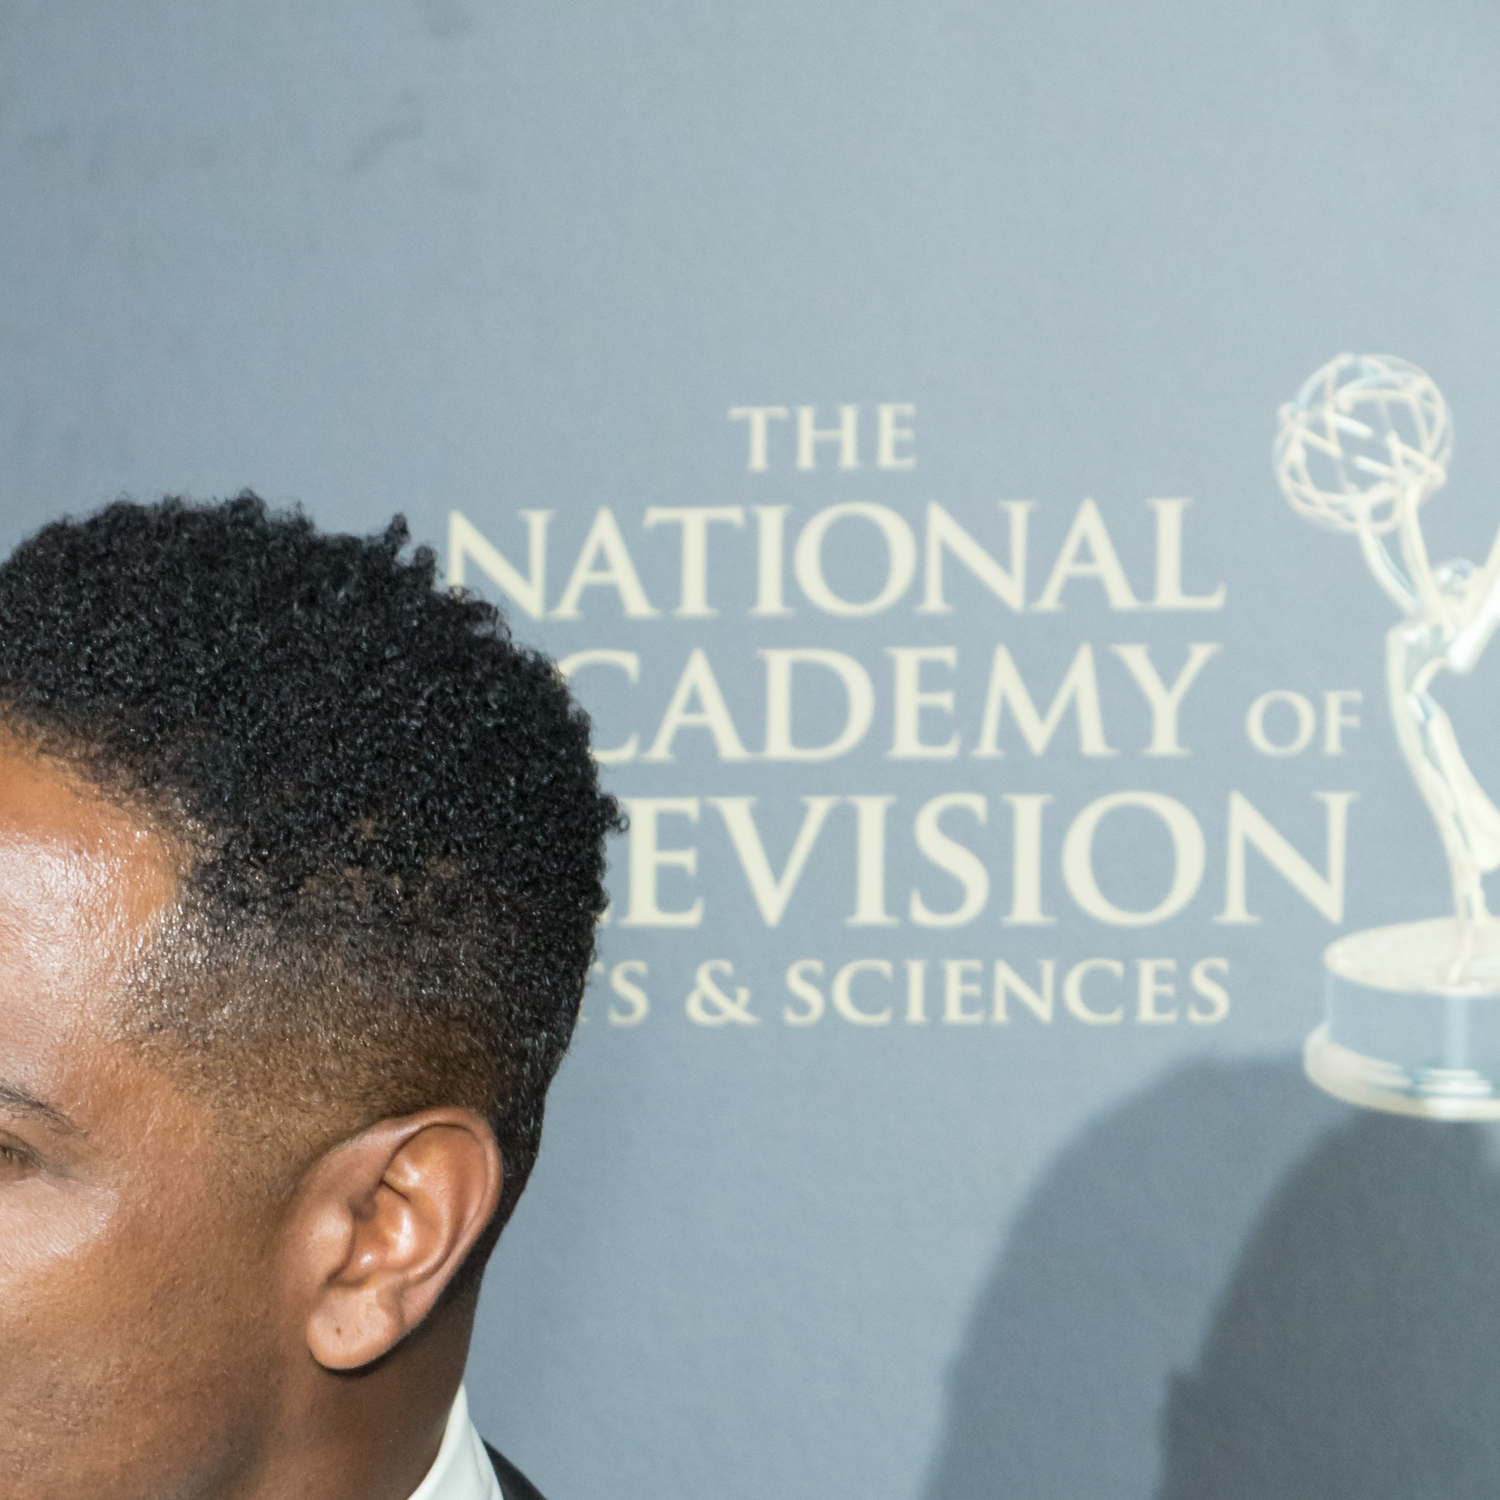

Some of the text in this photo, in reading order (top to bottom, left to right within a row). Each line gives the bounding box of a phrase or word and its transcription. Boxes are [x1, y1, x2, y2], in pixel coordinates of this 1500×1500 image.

[729, 404, 917, 472] THE
[448, 498, 1227, 618] NATIONAL
[556, 643, 1363, 762] CADEMY OF
[602, 791, 1361, 928] EVISION
[784, 958, 1231, 1026] SCIENCES
